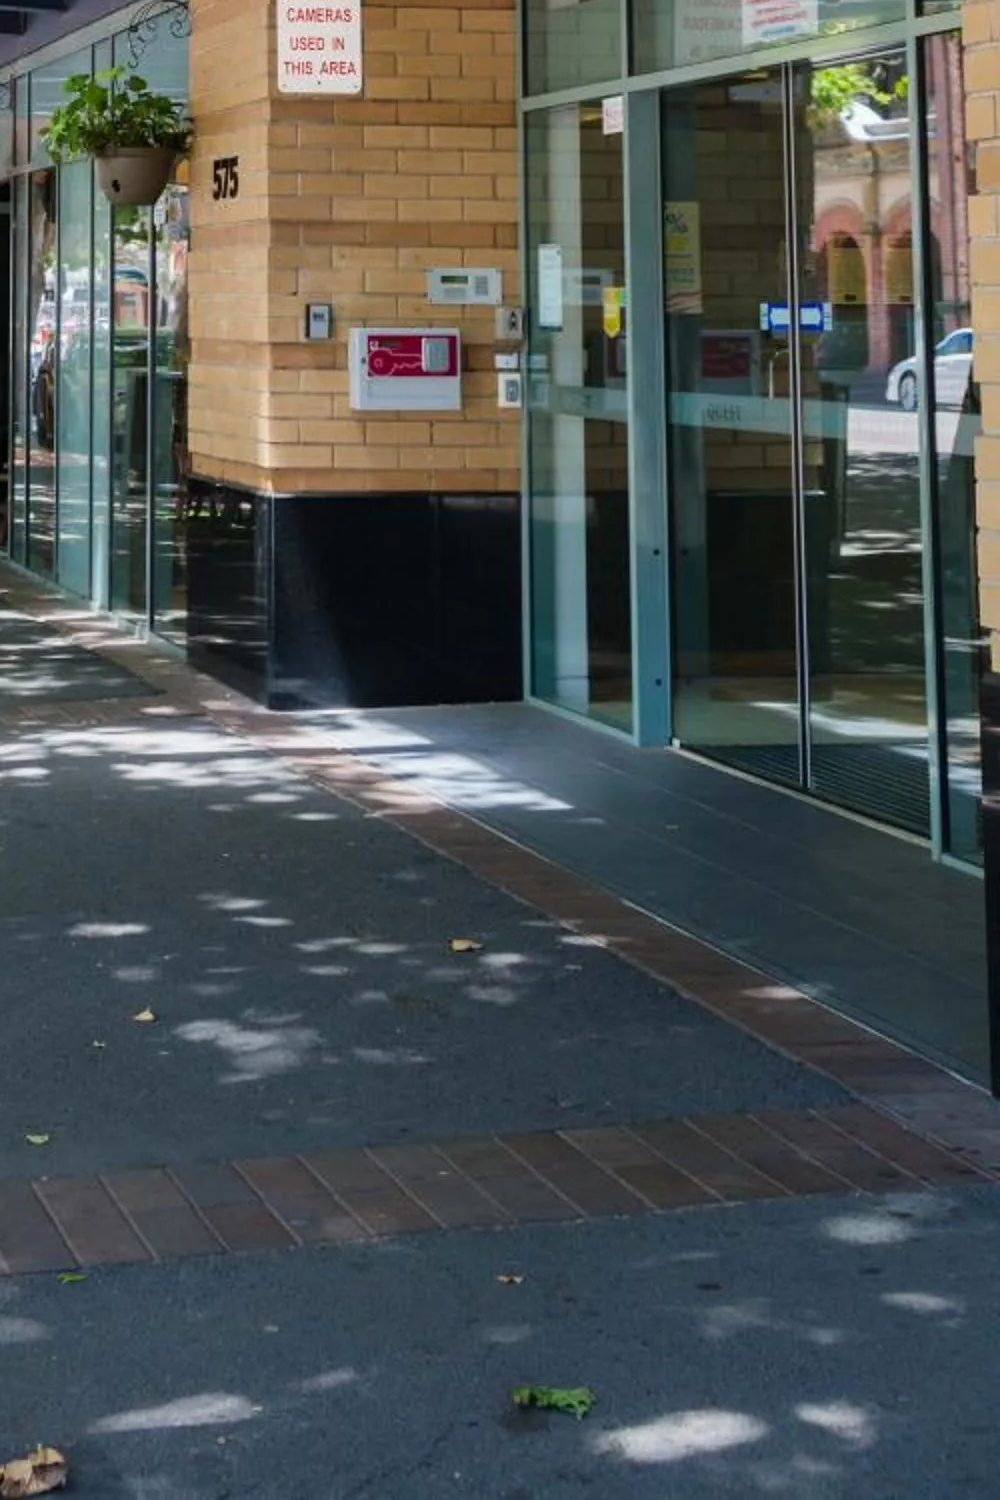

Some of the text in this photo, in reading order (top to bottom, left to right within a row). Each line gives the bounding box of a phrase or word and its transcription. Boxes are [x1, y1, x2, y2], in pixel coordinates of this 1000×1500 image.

[286, 7, 353, 24] CAMERAS
[290, 37, 345, 51] USED IN
[284, 61, 357, 76] THIS AREA
[213, 156, 239, 200] 575
